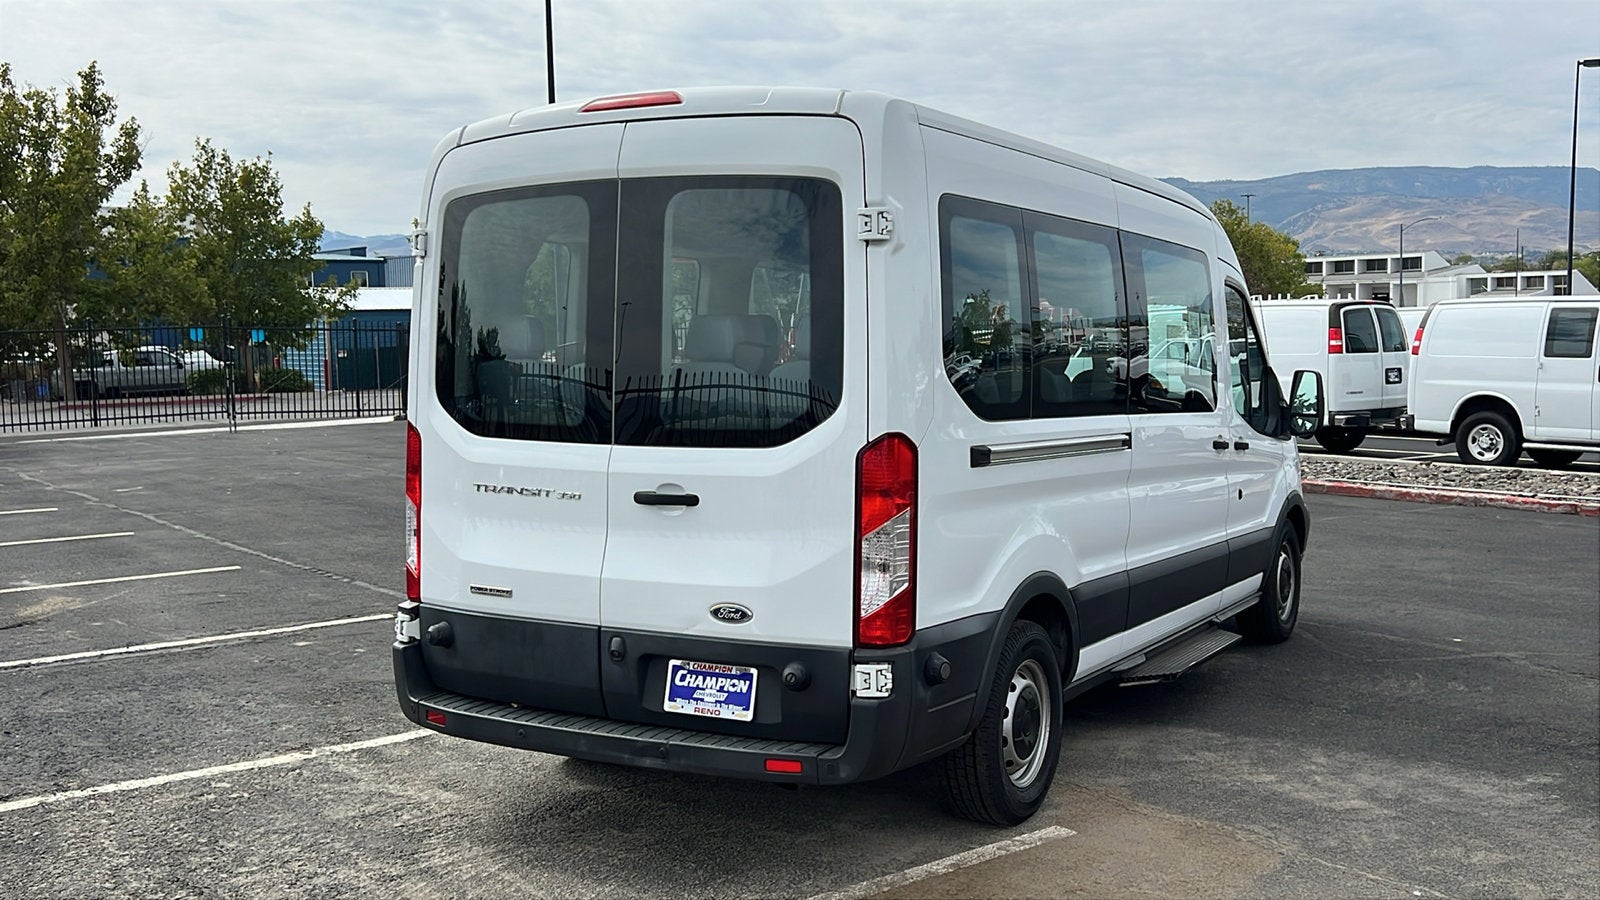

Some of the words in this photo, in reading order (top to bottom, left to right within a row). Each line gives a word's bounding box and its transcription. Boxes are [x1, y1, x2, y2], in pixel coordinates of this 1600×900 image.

[473, 483, 555, 497] TRANSIT
[718, 607, 742, 619] Ford
[693, 663, 733, 673] CHAMPION
[675, 670, 750, 693] CHAMPION
[696, 691, 725, 699] CHEVROLET
[694, 707, 721, 716] RENO
